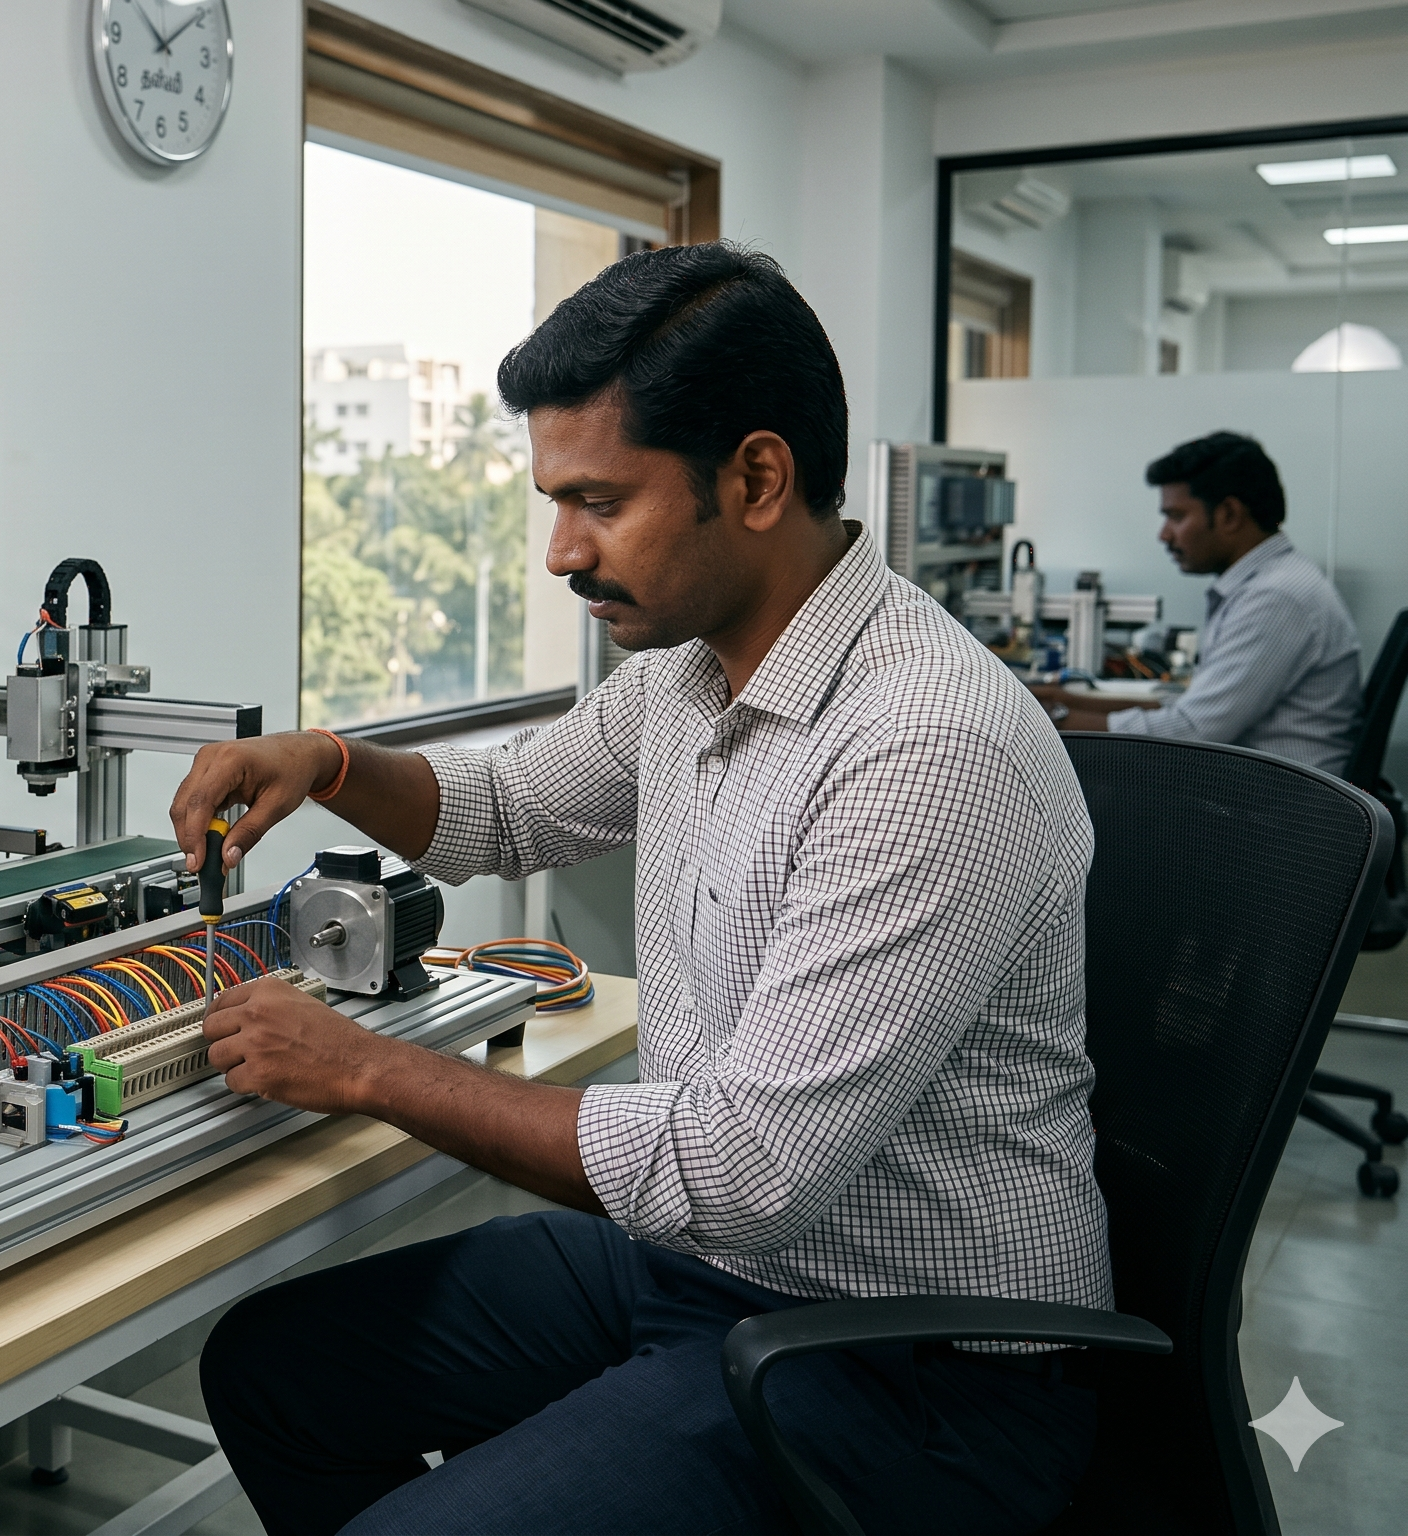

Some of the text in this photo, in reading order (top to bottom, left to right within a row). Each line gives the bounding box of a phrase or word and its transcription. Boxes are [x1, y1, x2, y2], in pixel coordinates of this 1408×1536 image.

[110, 21, 122, 44] 9
[200, 47, 211, 69] 3
[116, 64, 128, 87] 8
[194, 85, 205, 105] 4
[134, 99, 144, 122] 7
[178, 110, 189, 133] 5
[155, 115, 167, 138] 6
